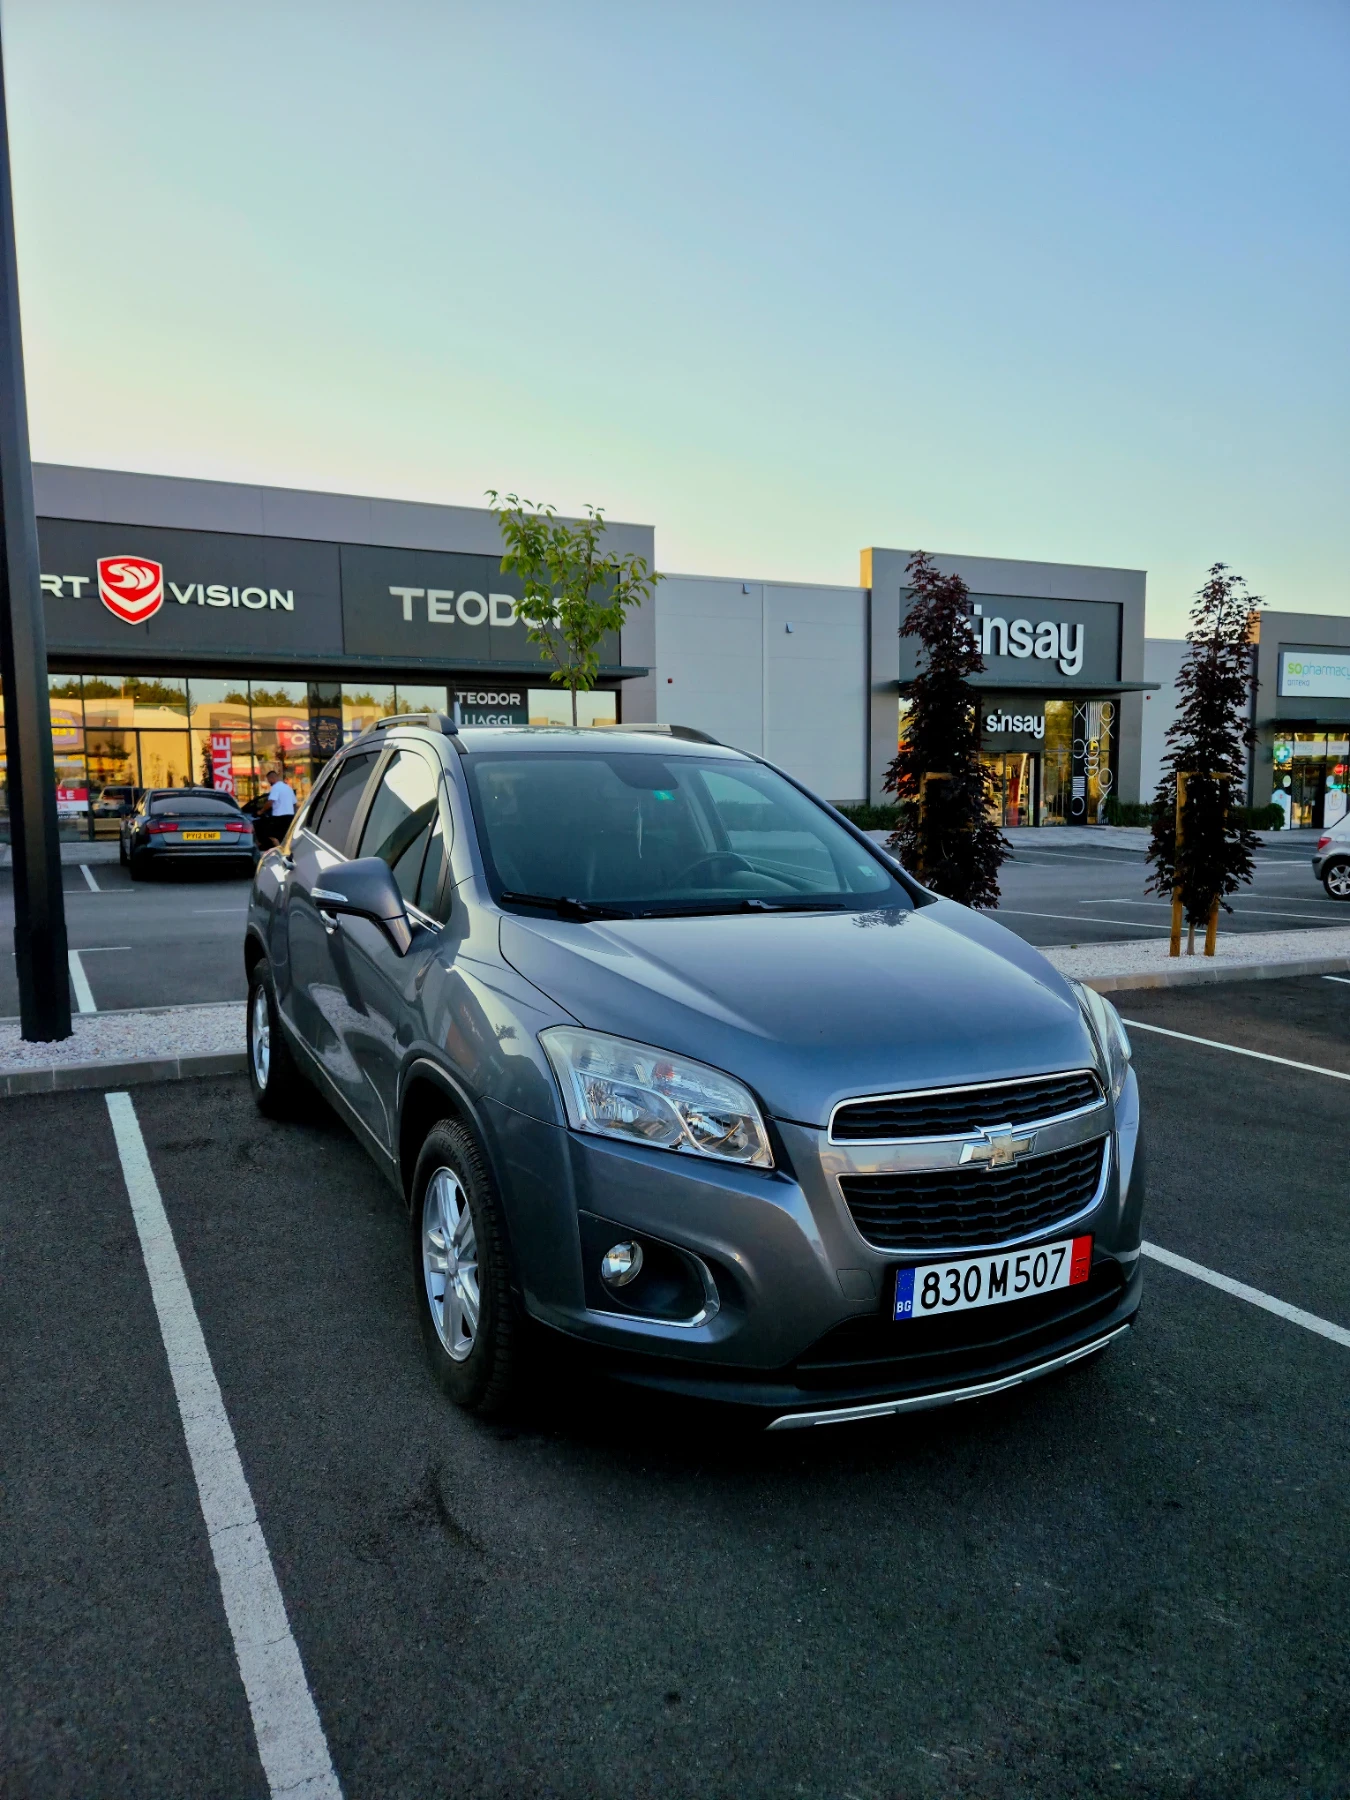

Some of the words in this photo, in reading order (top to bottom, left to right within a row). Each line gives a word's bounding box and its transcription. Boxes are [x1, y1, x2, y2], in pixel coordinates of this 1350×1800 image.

[168, 582, 294, 610] VISION
[455, 691, 521, 705] TEODOR
[986, 709, 1045, 739] sinsay
[212, 736, 233, 793] SALE
[921, 1264, 982, 1310] 830
[988, 1259, 1009, 1299] M
[1014, 1247, 1067, 1293] 507
[896, 1301, 912, 1313] BG
